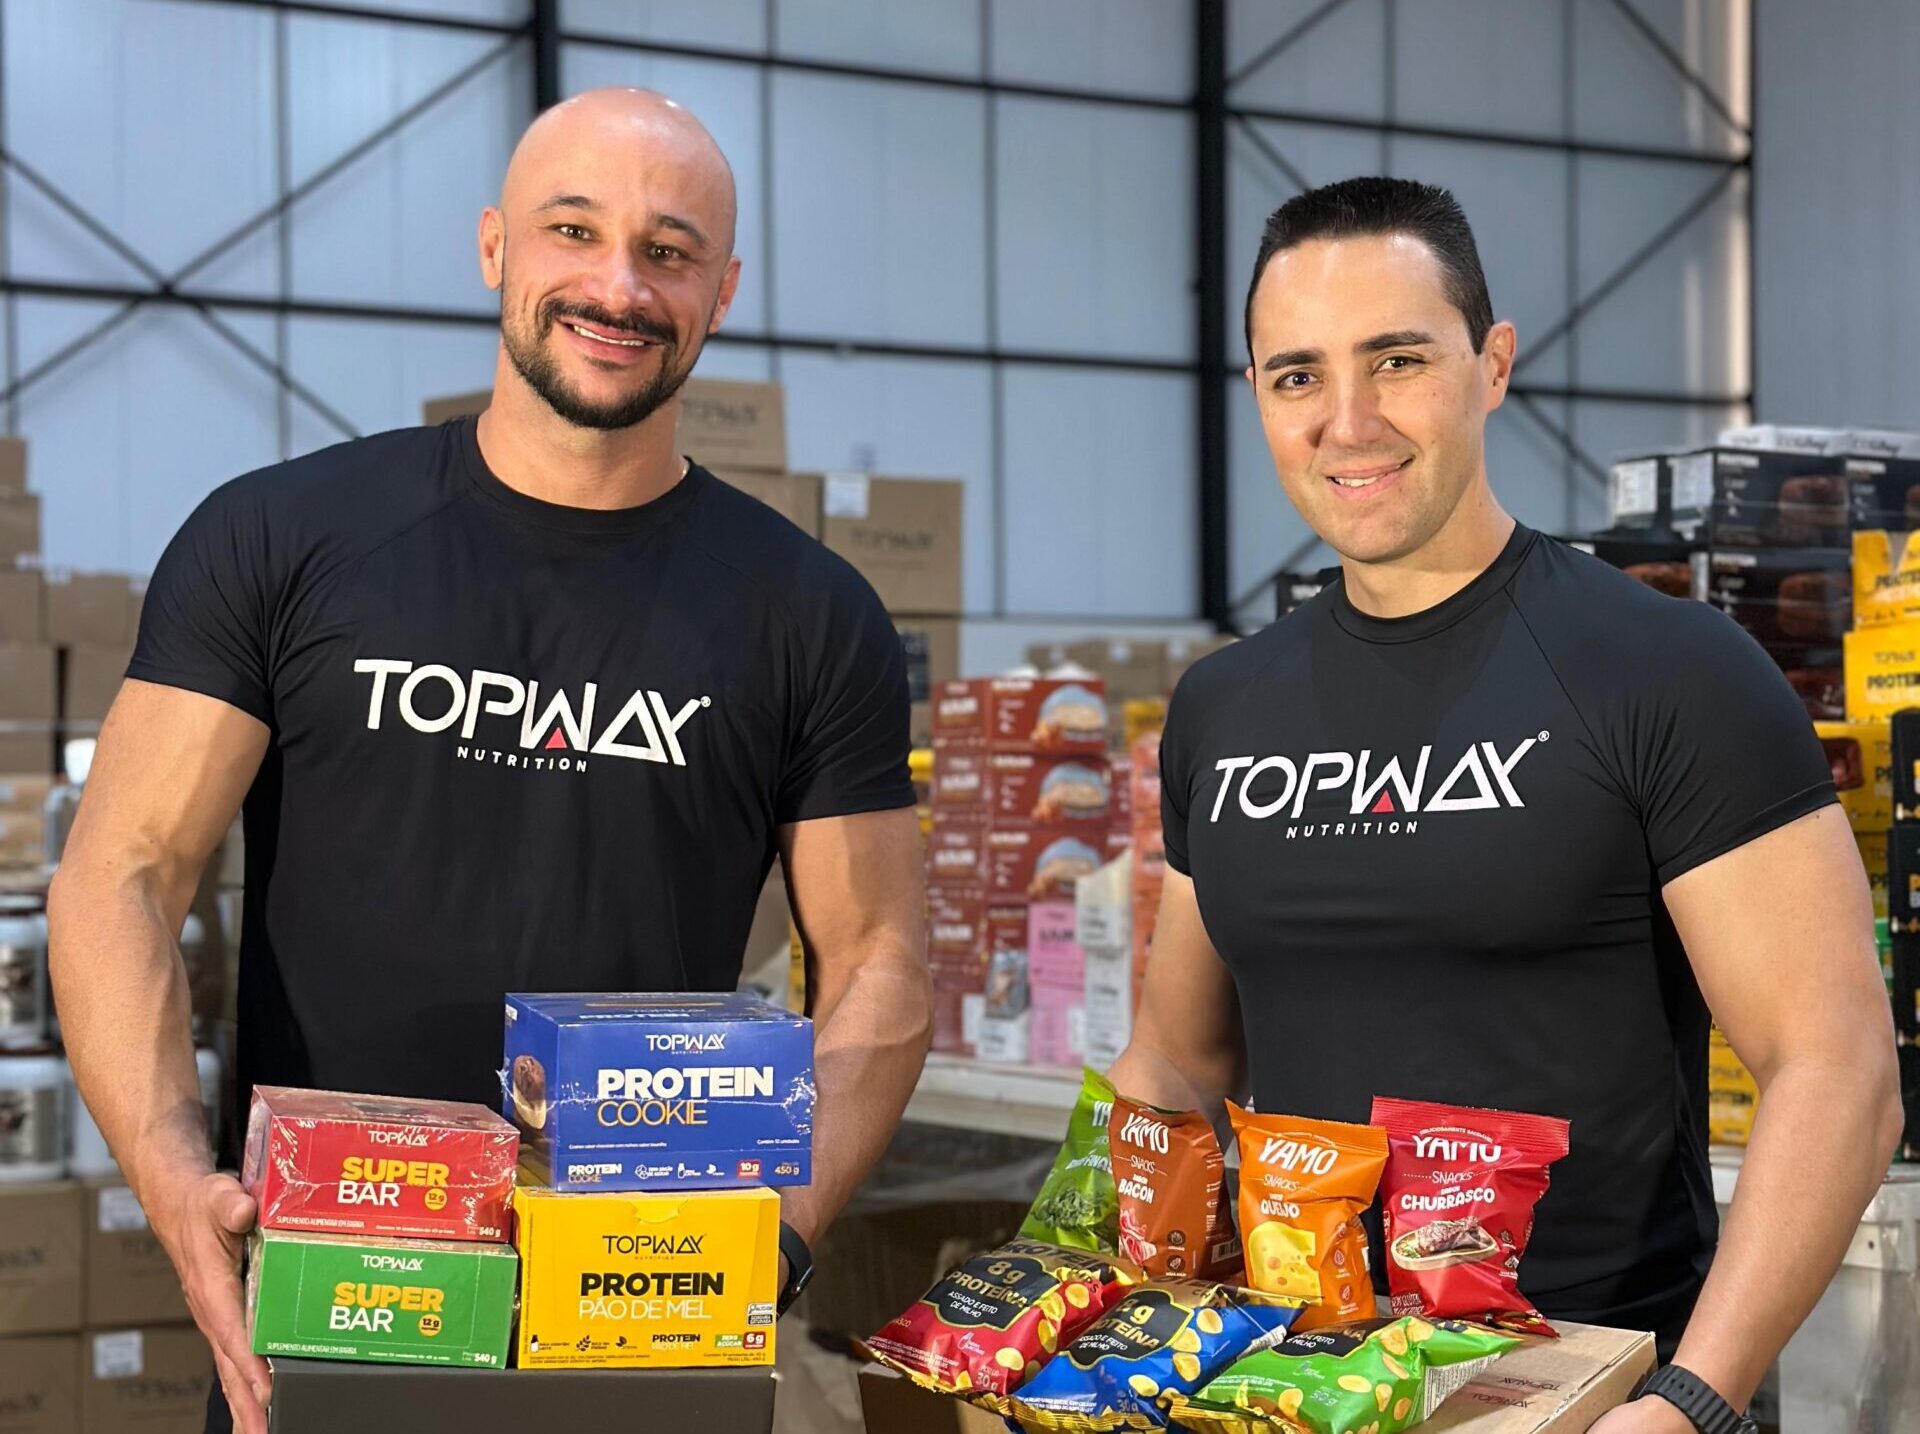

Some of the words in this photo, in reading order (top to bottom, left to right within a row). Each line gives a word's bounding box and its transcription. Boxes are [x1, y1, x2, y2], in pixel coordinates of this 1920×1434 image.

[457, 745, 588, 773] NUTRITION
[1286, 820, 1419, 839] NUTRITION
[645, 1033, 728, 1051] TOPWAY
[598, 1066, 774, 1100] PROTEIN
[598, 1099, 709, 1127] COOKIE
[368, 1130, 430, 1148] TOPWAY
[1119, 1112, 1169, 1154] YAMO
[1130, 1154, 1156, 1175] SNACKS
[1258, 1137, 1340, 1175] YAMO
[341, 1156, 450, 1187] SUPER
[568, 1163, 622, 1176] PROTEIN
[774, 1166, 792, 1175] 450
[793, 1167, 800, 1176] g
[1432, 1170, 1474, 1185] SNACKS
[1118, 1178, 1155, 1205] BACON
[1263, 1173, 1300, 1192] SNACKS
[337, 1180, 400, 1207] BAR
[428, 1193, 438, 1201] 12
[1400, 1187, 1496, 1211] CHURRASCO
[1260, 1198, 1301, 1219] QUEIJO
[479, 1226, 494, 1236] 540
[494, 1228, 501, 1238] g
[601, 1235, 705, 1255] TOPWAY
[360, 1254, 424, 1272] TOPWAY
[580, 1271, 725, 1297] PROTEIN
[946, 1271, 1029, 1308] PROTEÍNA
[333, 1281, 445, 1313] SUPER
[948, 1291, 974, 1306] ASSADO
[979, 1303, 998, 1314] FEITO
[579, 1296, 628, 1320] PÃO
[630, 1300, 662, 1319] DE
[666, 1298, 712, 1319] MEL
[950, 1301, 961, 1309] DE
[960, 1306, 982, 1318] MILHO
[329, 1305, 394, 1333] BAR
[422, 1318, 433, 1327] 12
[433, 1319, 440, 1329] g
[652, 1333, 701, 1343] PROTEIN
[1095, 1318, 1160, 1349] OTEÍNA
[1106, 1336, 1128, 1350] FEITO
[1293, 1339, 1317, 1348] MILHO
[1313, 1335, 1335, 1345] FEITO
[474, 1353, 490, 1362] 540
[490, 1354, 498, 1364] g
[975, 1372, 990, 1387] 30
